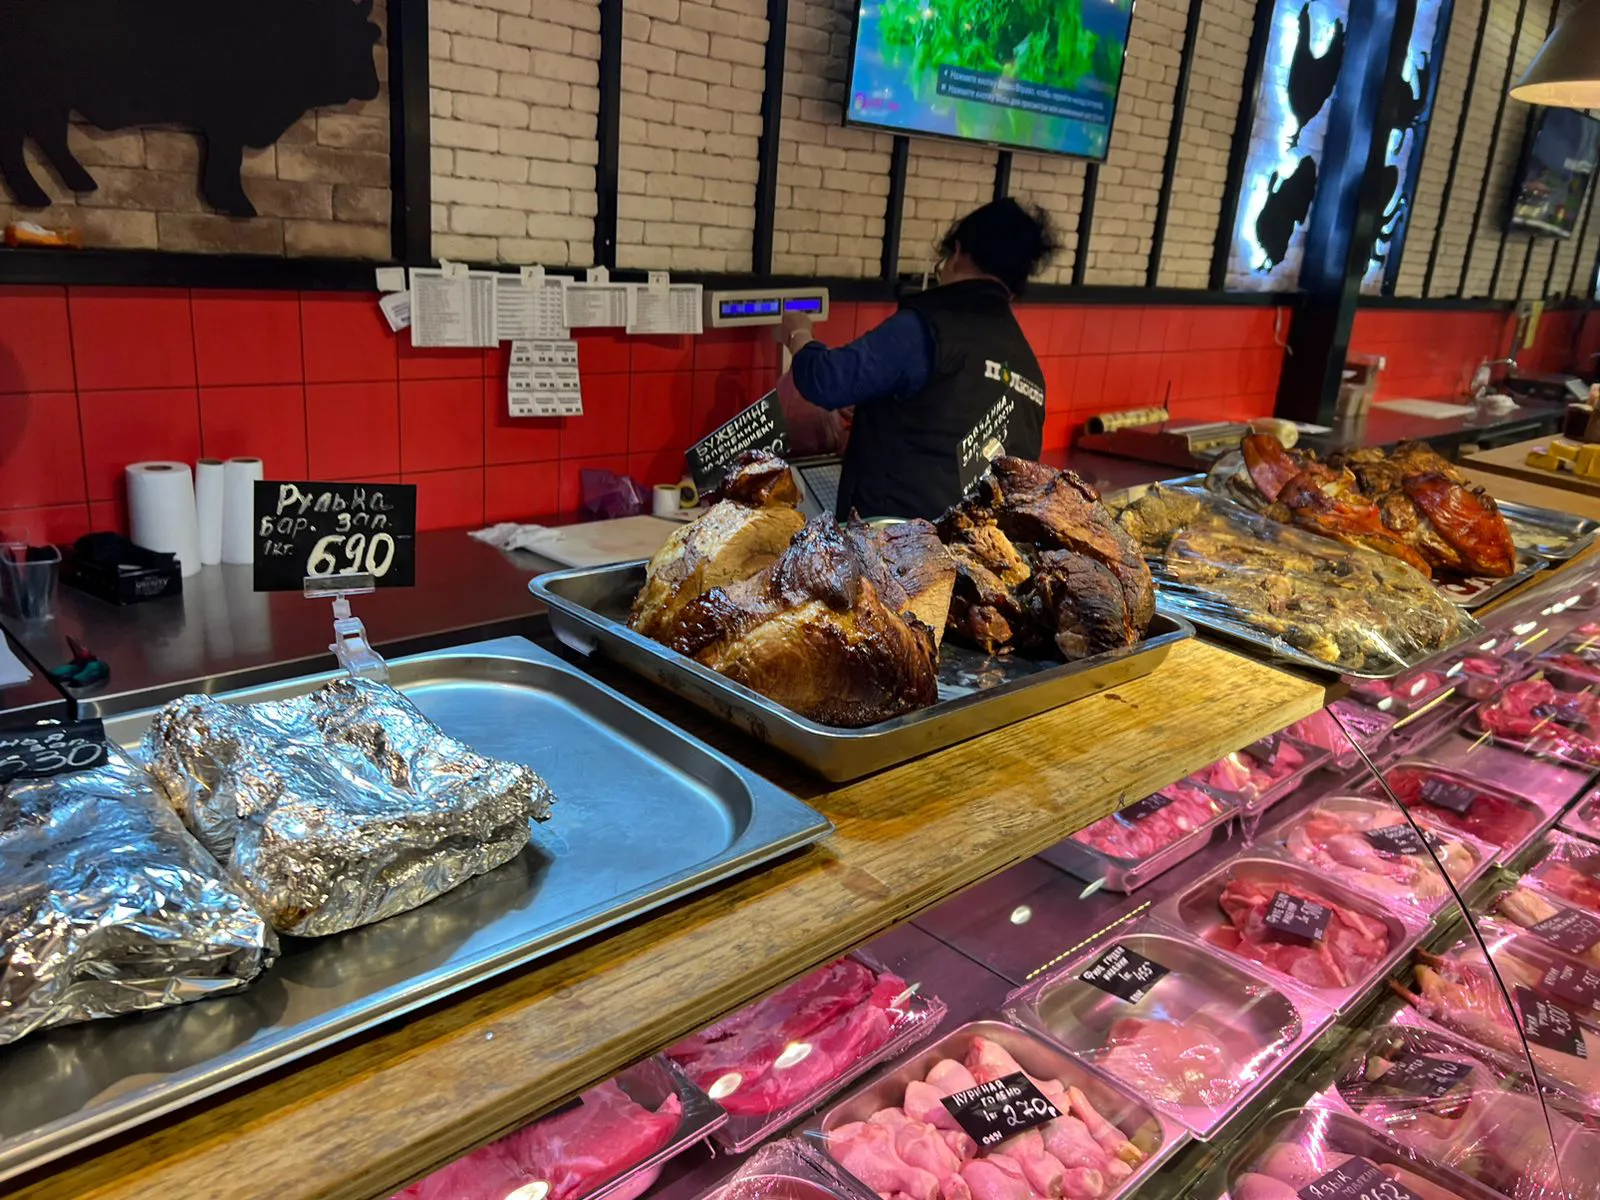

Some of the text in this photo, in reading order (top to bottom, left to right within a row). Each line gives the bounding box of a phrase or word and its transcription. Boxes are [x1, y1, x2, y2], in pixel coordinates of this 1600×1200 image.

[696, 400, 770, 456] БУЖЕНИНА
[952, 1079, 1006, 1107] КУРИНАЯ
[980, 1086, 1022, 1107] ГОЛЕНЬ
[1309, 1169, 1353, 1199] ЯЗЫК
